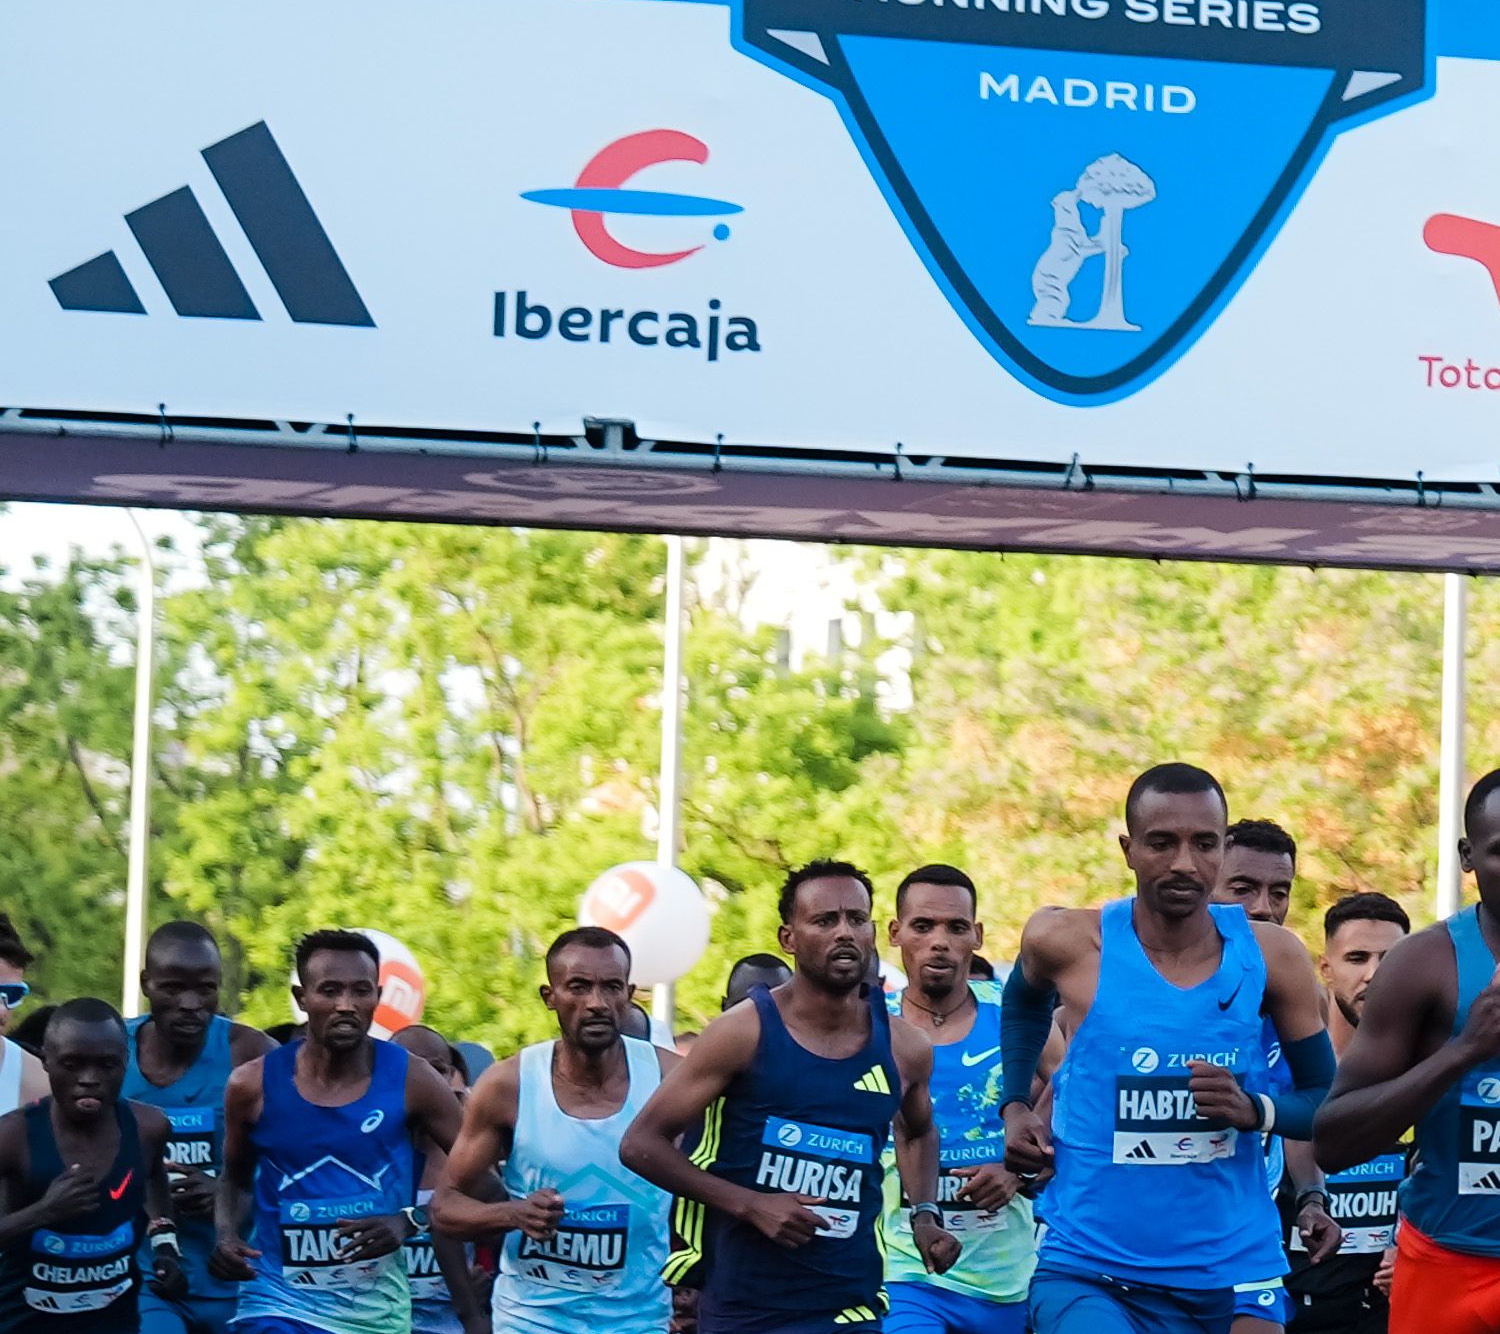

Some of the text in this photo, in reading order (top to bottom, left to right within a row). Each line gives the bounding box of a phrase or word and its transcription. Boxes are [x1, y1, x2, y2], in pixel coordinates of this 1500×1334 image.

[978, 71, 1198, 115] MADRID
[491, 289, 762, 362] Ibercaja
[806, 1133, 864, 1156] ZURICH
[940, 1143, 998, 1162] ZURICH
[755, 1151, 863, 1203] HURISA
[316, 1200, 375, 1218] ZURICH
[71, 1234, 126, 1253] ZURICH
[32, 1254, 131, 1284] CHELANGAT
